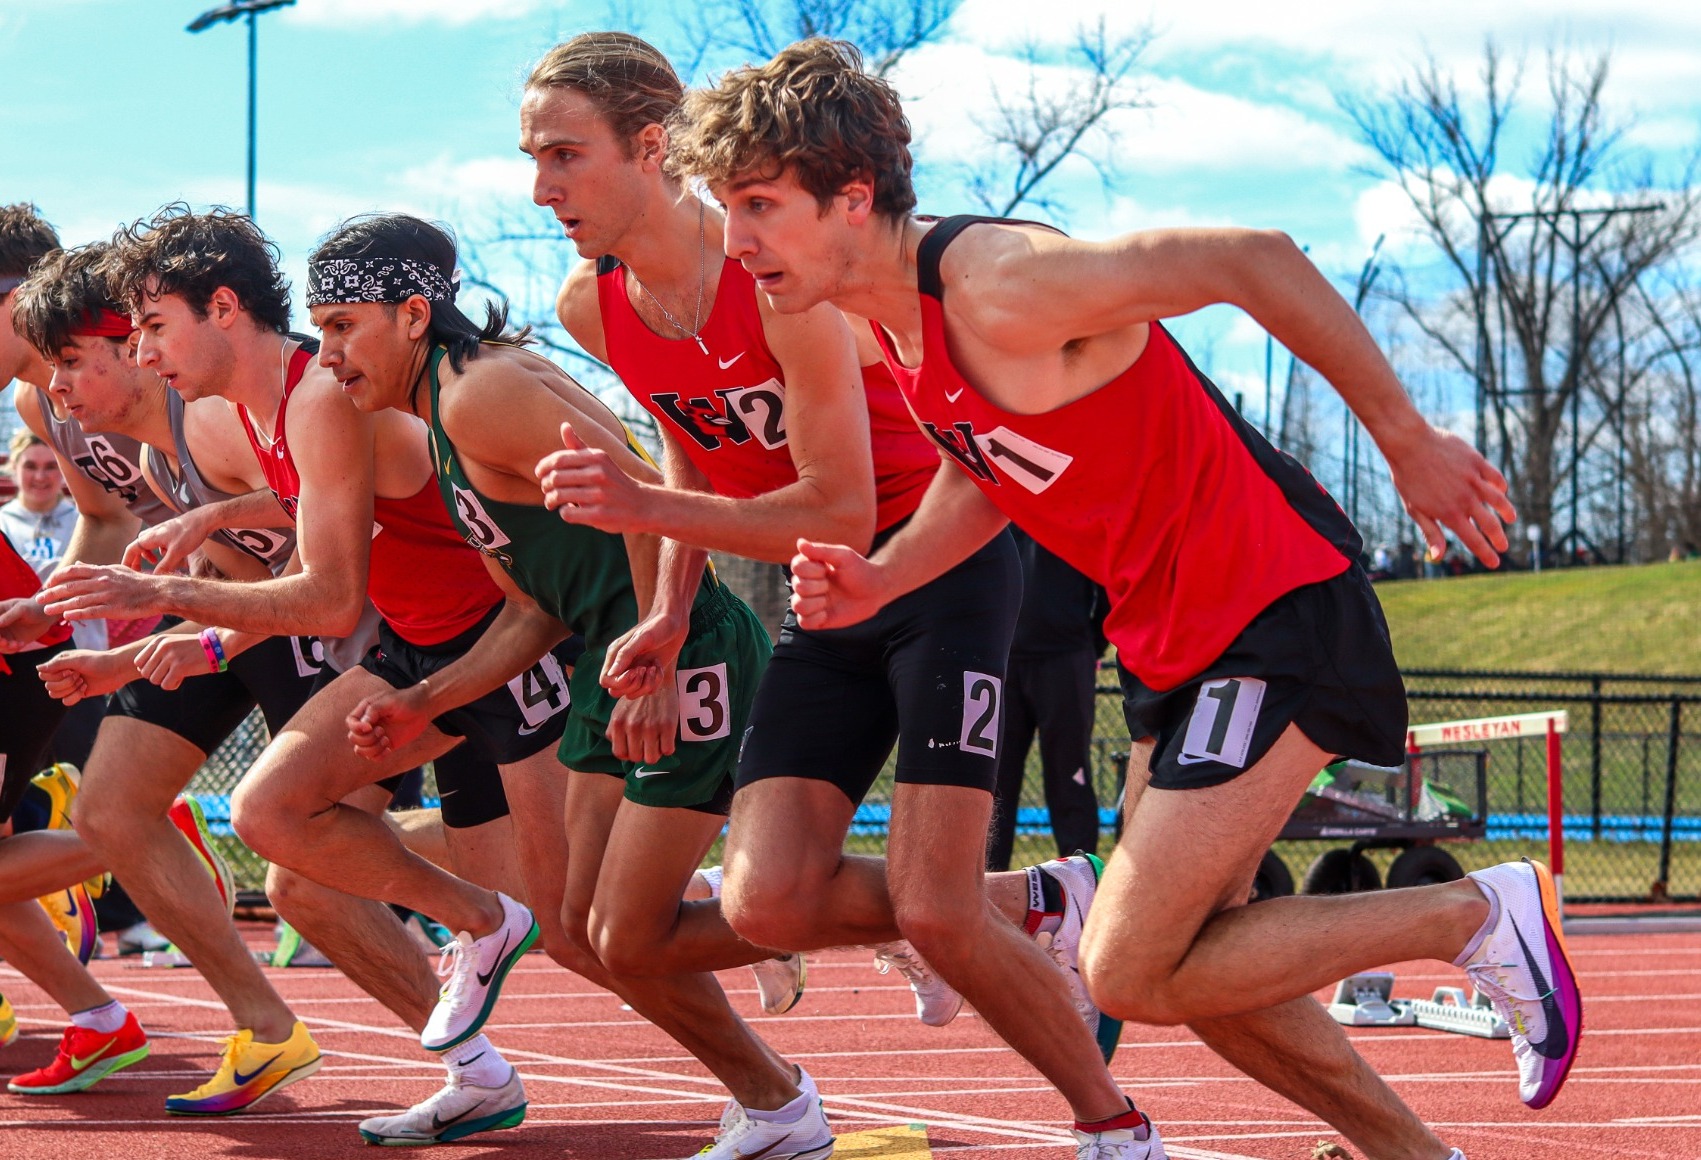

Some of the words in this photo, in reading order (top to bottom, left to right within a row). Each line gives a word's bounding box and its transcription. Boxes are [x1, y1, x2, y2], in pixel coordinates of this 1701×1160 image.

[739, 390, 787, 445] 2
[91, 441, 132, 481] 6
[988, 438, 1055, 482] 1
[455, 490, 495, 546] 3
[523, 661, 562, 710] 4
[686, 671, 724, 737] 3
[966, 678, 996, 752] 2
[1205, 678, 1241, 756] 1
[1441, 720, 1521, 741] WESLEYAN
